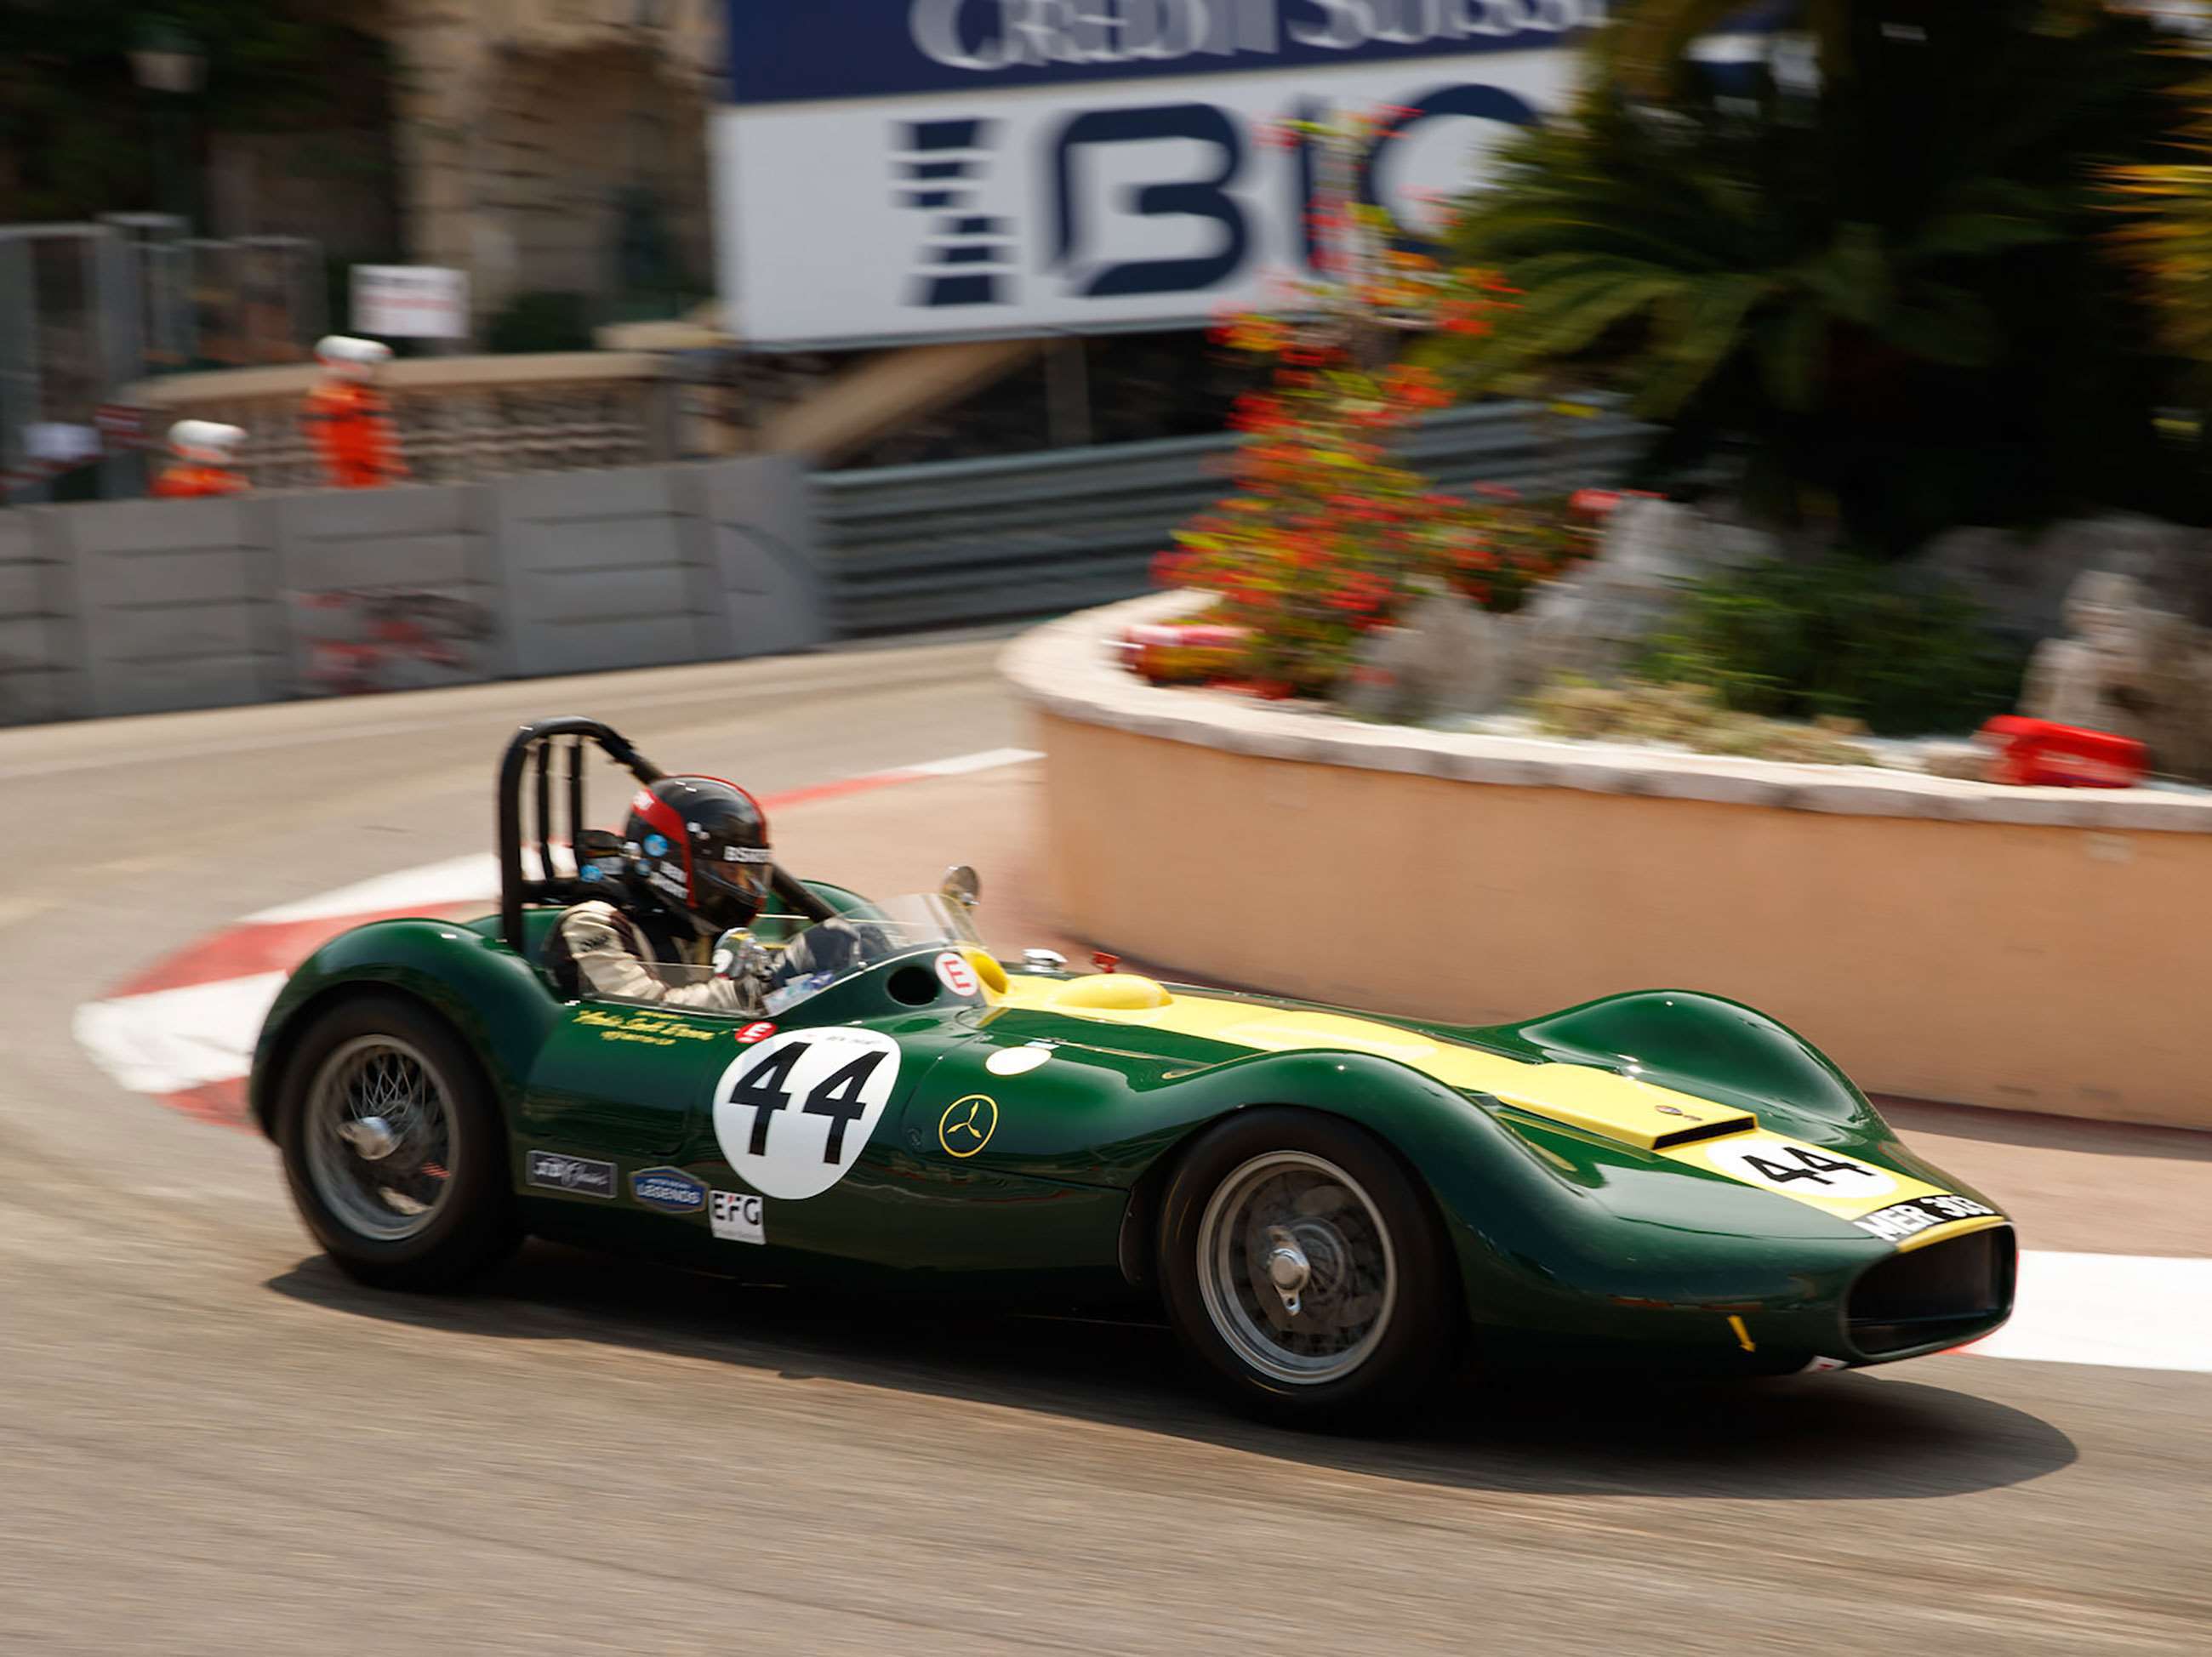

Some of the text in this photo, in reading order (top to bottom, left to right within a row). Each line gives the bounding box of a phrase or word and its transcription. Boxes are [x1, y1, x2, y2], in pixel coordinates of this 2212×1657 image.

[940, 959, 972, 989] E
[743, 1022, 772, 1037] E
[728, 1040, 889, 1165] 44
[1741, 1146, 1876, 1185] 44
[713, 1193, 761, 1226] EFG
[1853, 1204, 1947, 1241] MER
